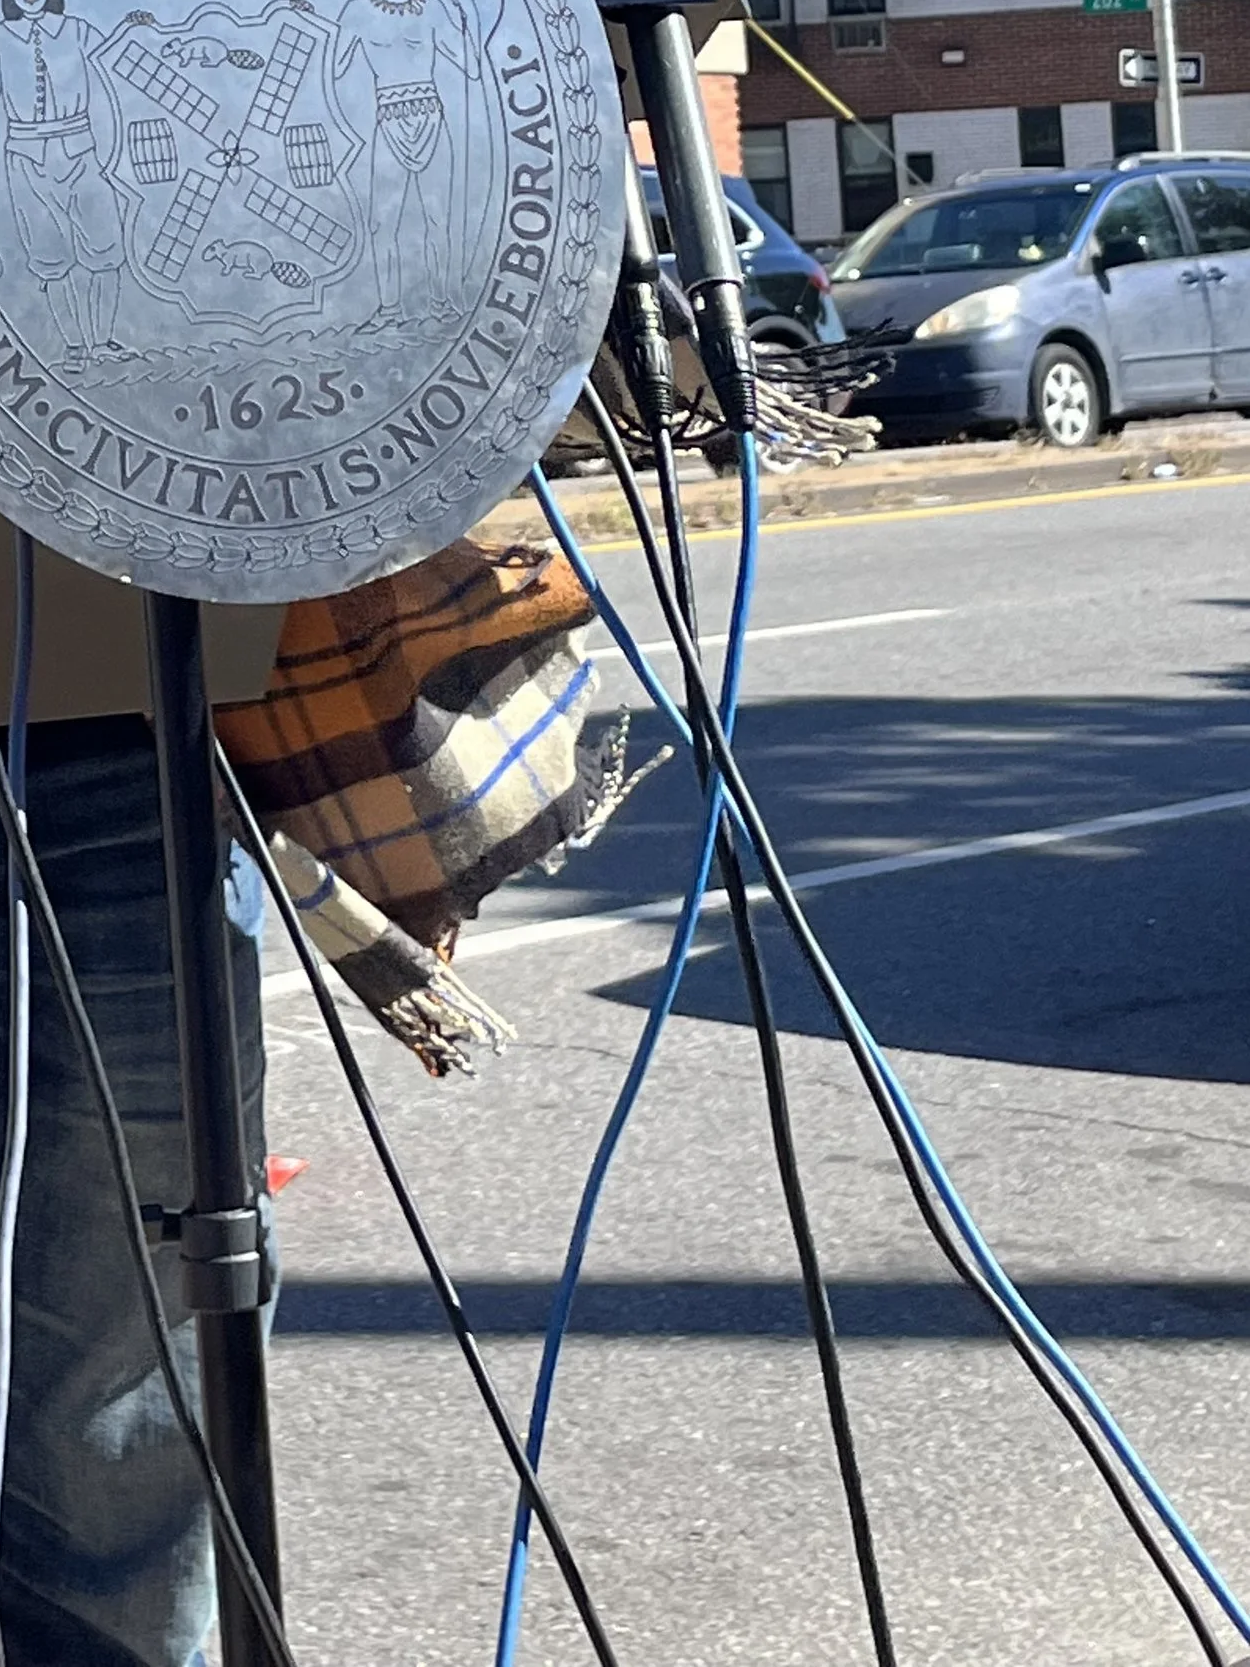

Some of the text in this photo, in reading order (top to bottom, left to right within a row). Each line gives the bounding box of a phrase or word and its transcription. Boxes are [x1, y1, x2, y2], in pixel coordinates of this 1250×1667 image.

[49, 409, 381, 522] CIVITATIS
[383, 328, 513, 465] NOVI
[487, 58, 554, 327] EBORACI
[200, 368, 345, 432] 1625
